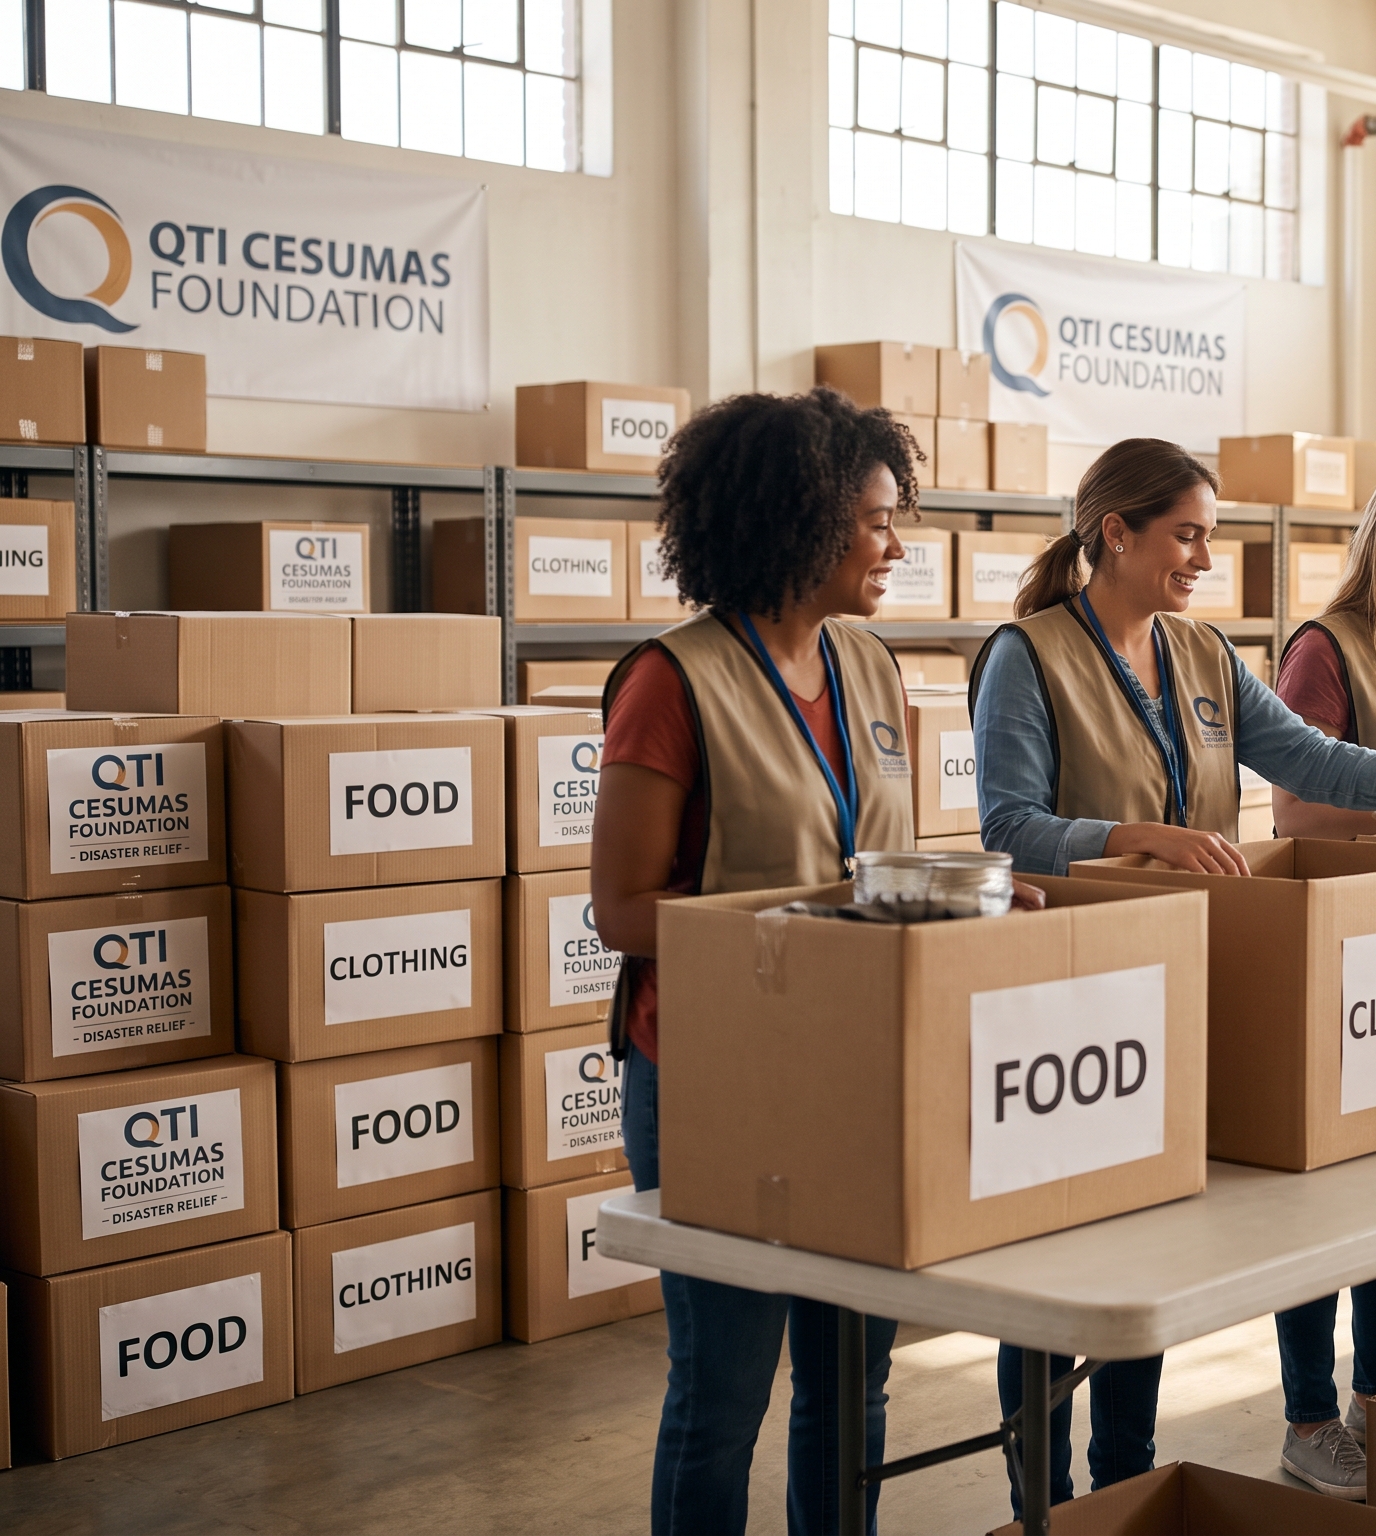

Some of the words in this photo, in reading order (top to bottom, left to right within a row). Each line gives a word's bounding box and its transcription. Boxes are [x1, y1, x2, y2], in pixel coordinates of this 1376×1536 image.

[149, 221, 227, 267] QTI
[242, 231, 451, 288] CESUMAS
[152, 271, 443, 334] FOUNDATION
[1059, 316, 1101, 348] QTI
[1109, 322, 1226, 361] CESUMAS
[1059, 353, 1223, 396] FOUNDATION
[611, 417, 668, 439] FOOD
[295, 537, 337, 561] QTI
[531, 557, 608, 574] CLOTHING
[281, 579, 351, 588] FOUNDATION
[282, 564, 351, 577] CESUMAS
[91, 753, 164, 791] QTI
[69, 793, 188, 819] CESUMAS
[345, 781, 459, 820] FOOD
[69, 816, 189, 838] FOUNDATION
[79, 846, 140, 861] DISASTER
[143, 843, 182, 856] RELIEF
[93, 929, 167, 970] QTI
[330, 944, 467, 981] CLOTHING
[71, 969, 191, 1001] CESUMAS
[72, 992, 192, 1021] FOUNDATION
[83, 1025, 143, 1043] DISASTER
[146, 1020, 186, 1035] RELIEF
[995, 1039, 1147, 1123] FOOD
[124, 1104, 199, 1148] QTI
[352, 1099, 460, 1150] FOOD
[570, 1131, 615, 1148] DISASTER
[100, 1142, 224, 1182] CESUMAS
[101, 1166, 224, 1202] FOUNDATION
[112, 1203, 174, 1225] DISASTER
[177, 1195, 218, 1212] RELIEF
[339, 1257, 472, 1309] CLOTHING
[118, 1315, 247, 1378] FOOD
